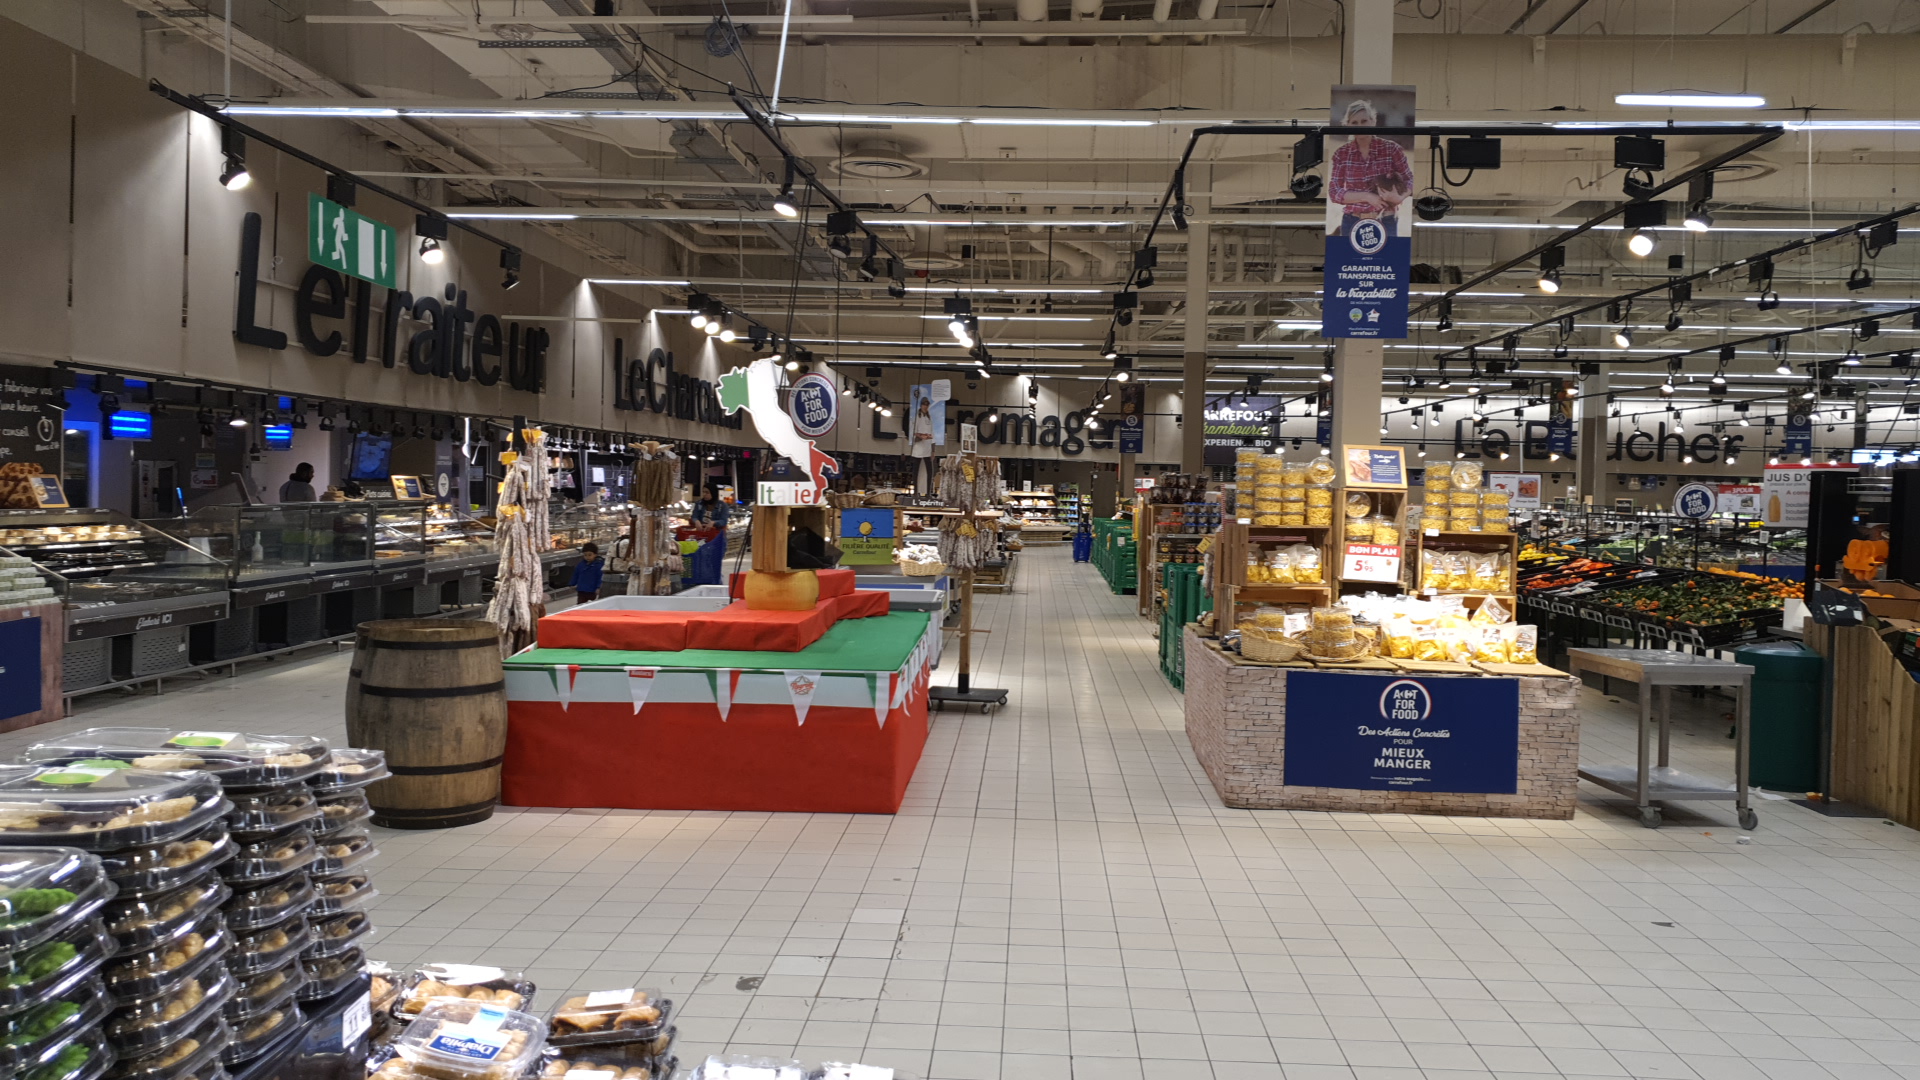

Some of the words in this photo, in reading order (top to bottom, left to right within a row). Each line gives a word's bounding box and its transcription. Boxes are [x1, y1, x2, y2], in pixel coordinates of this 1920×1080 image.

[1362, 232, 1375, 240] FOR
[1361, 238, 1379, 247] FOOD
[236, 211, 346, 357] Le
[1336, 288, 1348, 298] la
[1348, 288, 1398, 300] traçabilité
[614, 338, 646, 411] Le
[804, 398, 823, 413] FOR
[804, 408, 828, 425] FOOD
[1204, 409, 1273, 421] ARREFOUR
[946, 409, 1122, 455] romager
[1255, 439, 1272, 447] BIO
[1455, 419, 1510, 458] Le
[1525, 420, 1744, 464] Bucher
[1767, 473, 1791, 482] JUS
[760, 483, 812, 505] Italie
[1688, 499, 1703, 508] FOR
[1688, 505, 1707, 515] FOOD
[842, 541, 865, 550] FILIÈRE
[865, 541, 890, 550] QUALITÉ
[1349, 545, 1371, 555] BON
[1371, 547, 1398, 556] PLAN
[1353, 559, 1363, 571] 5
[1395, 700, 1415, 710] FOR
[1392, 709, 1419, 720] FOOD
[1358, 725, 1376, 736] Des
[1377, 726, 1411, 737] Actions
[1412, 727, 1450, 738] Concrètes
[1381, 747, 1425, 758] MIEUX
[1374, 758, 1431, 769] MANGER
